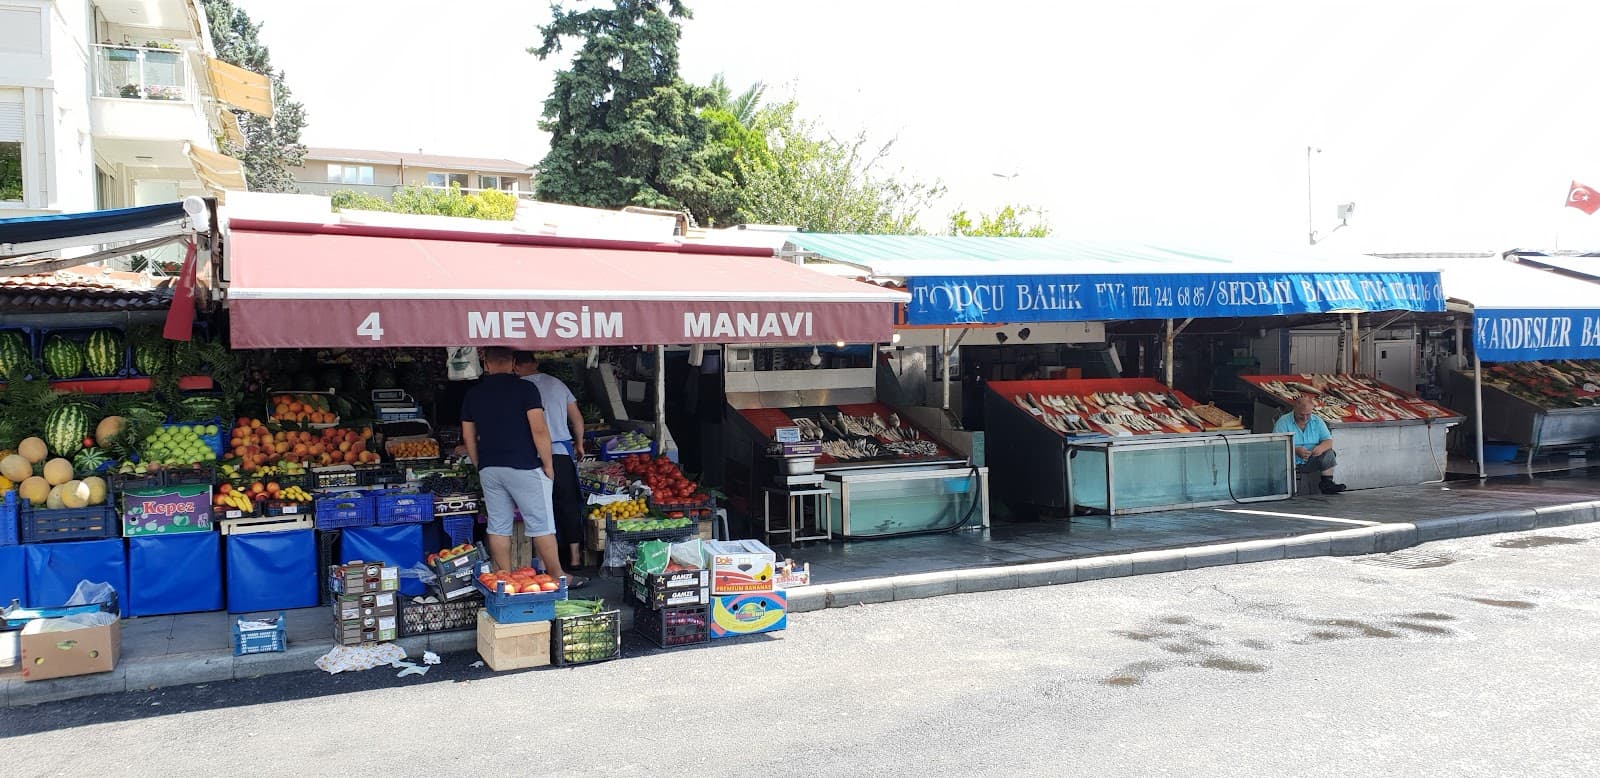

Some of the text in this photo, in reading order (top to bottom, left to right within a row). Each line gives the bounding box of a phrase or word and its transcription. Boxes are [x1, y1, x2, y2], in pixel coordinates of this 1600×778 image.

[913, 283, 1005, 315] TOPÇU
[1016, 283, 1083, 311] BALIK
[1131, 285, 1152, 307] TEL
[1155, 286, 1173, 307] 242
[1178, 286, 1190, 307] 68
[1300, 279, 1360, 303] BALIK
[356, 305, 814, 341] 4 MEVSİM MANAVI
[1477, 316, 1572, 352] KARDEŞLER
[142, 501, 196, 517] Kepez
[715, 556, 733, 564] Dole
[716, 581, 772, 592] PREMIUM BANANAS
